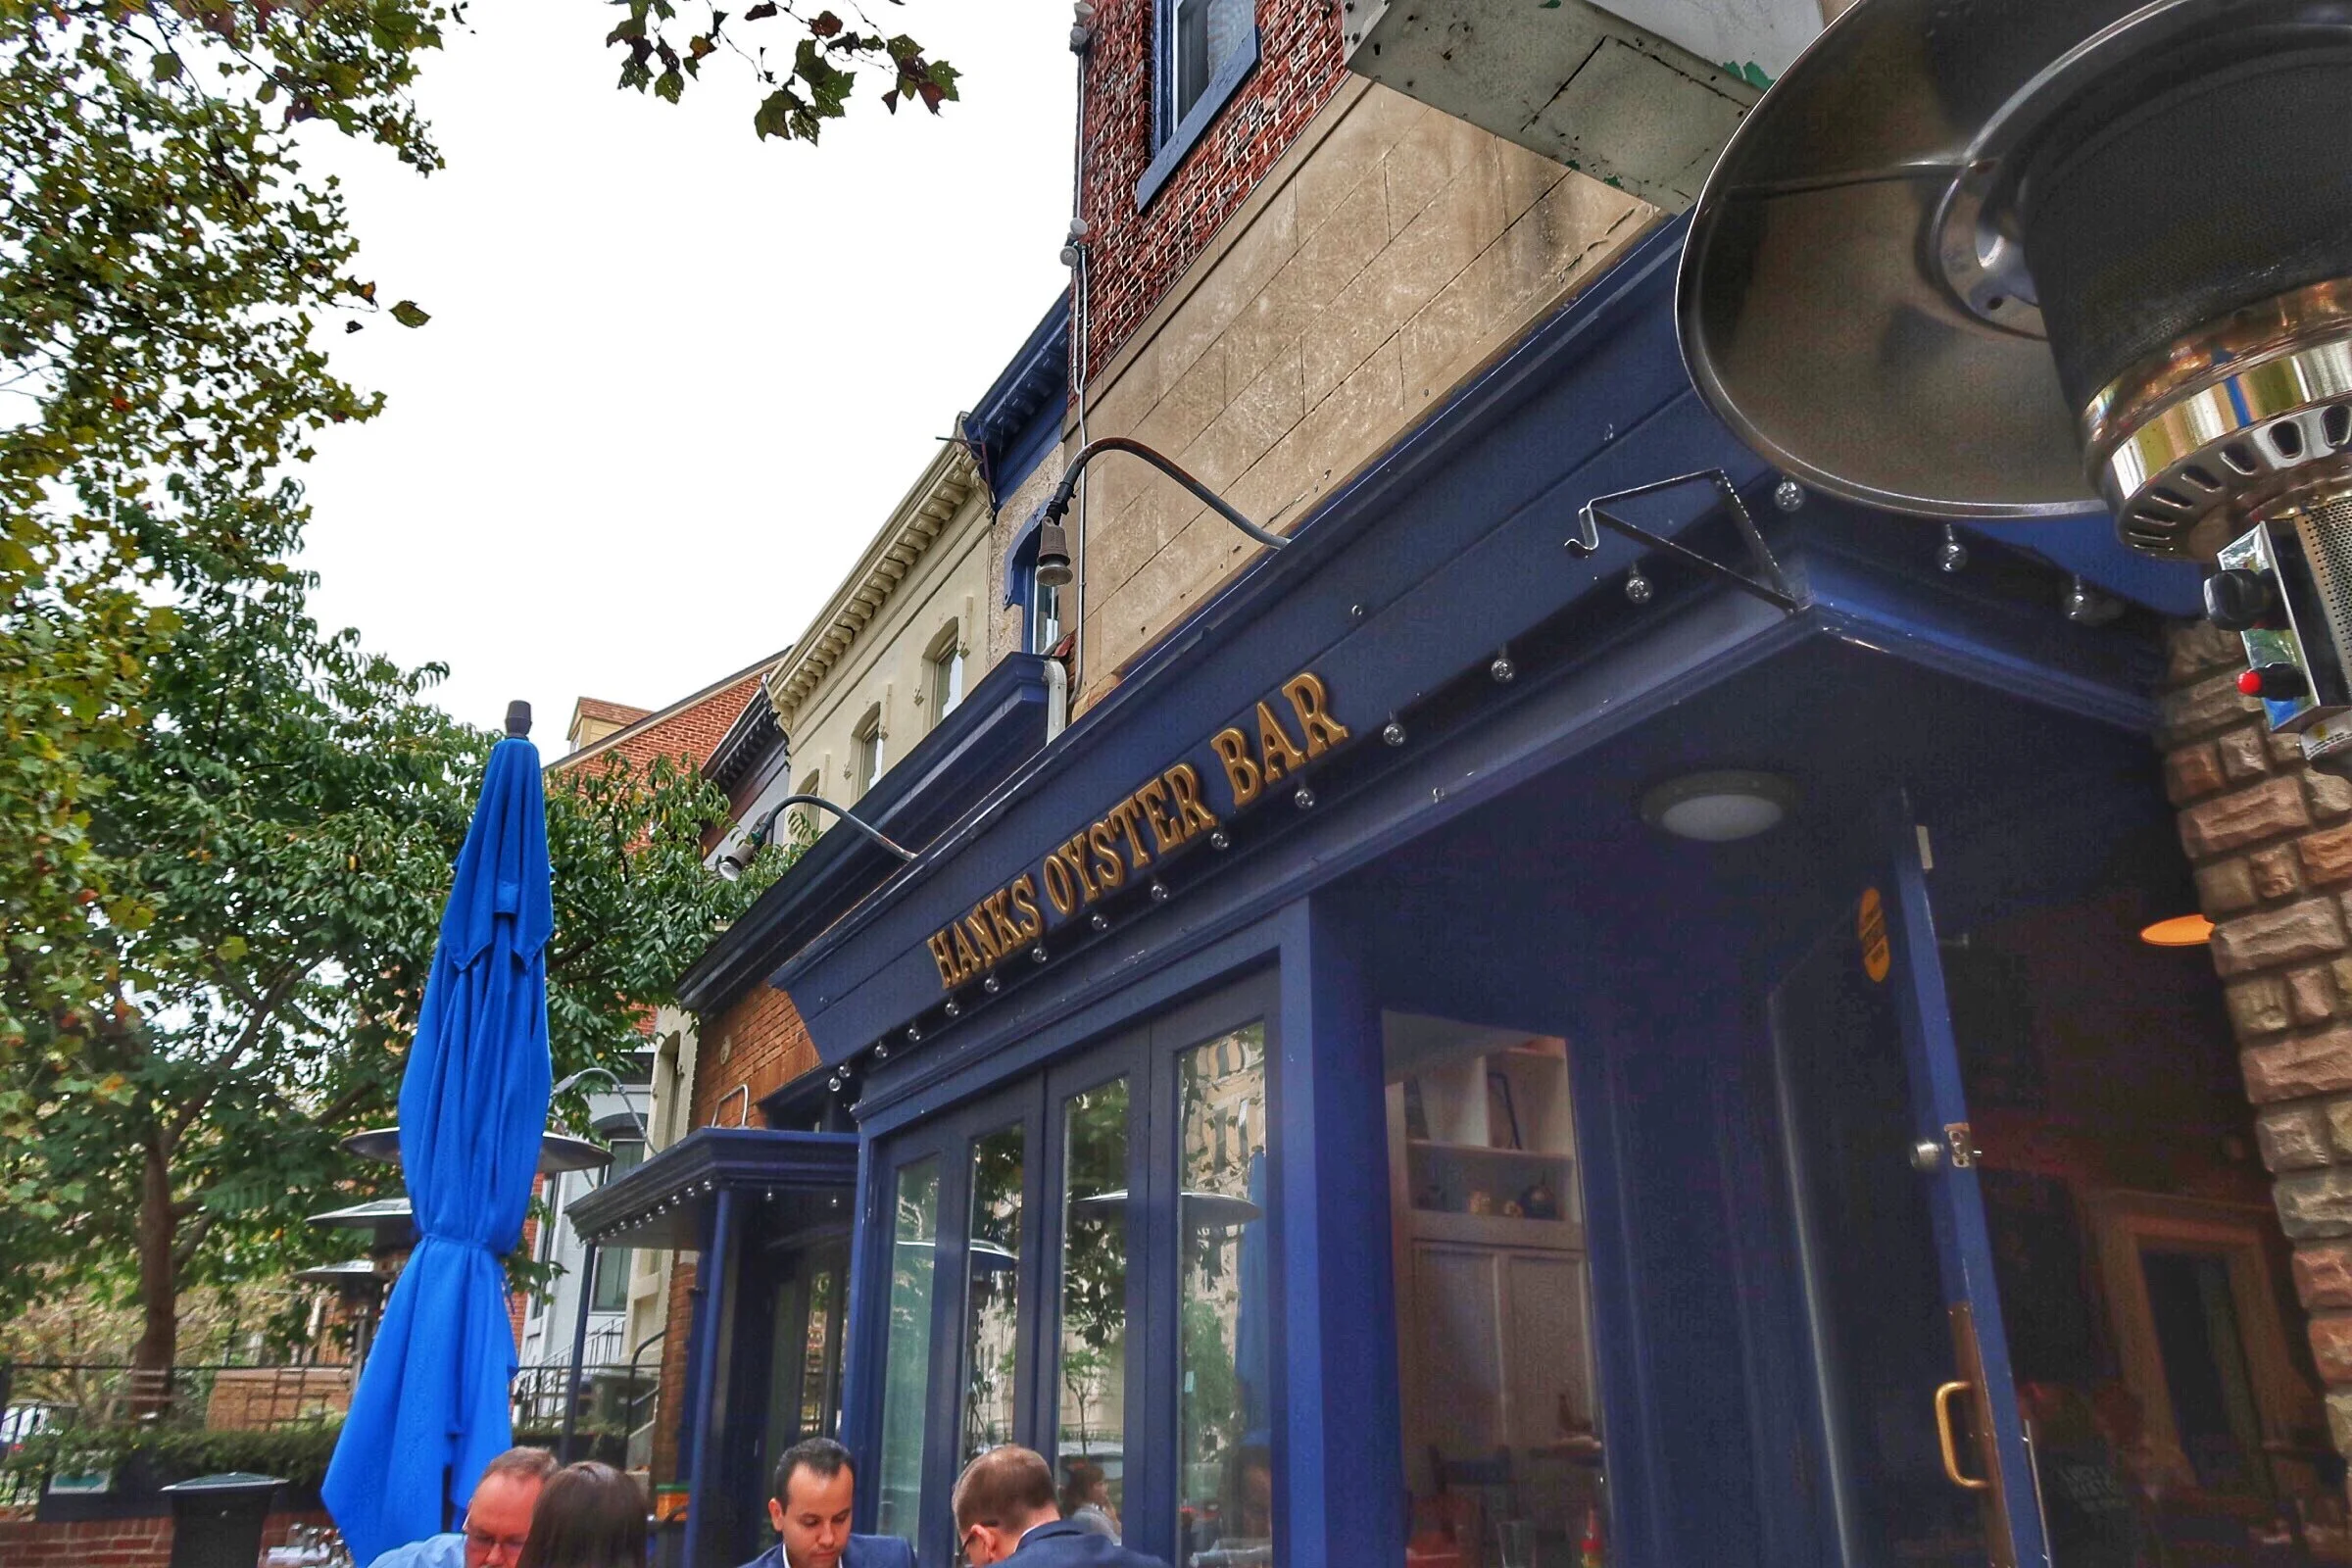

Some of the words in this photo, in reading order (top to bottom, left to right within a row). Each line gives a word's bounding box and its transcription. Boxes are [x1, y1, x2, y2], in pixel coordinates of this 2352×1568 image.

[927, 873, 1044, 989] HANKS
[1043, 762, 1218, 915] OYSTER
[1210, 671, 1349, 807] BAR
